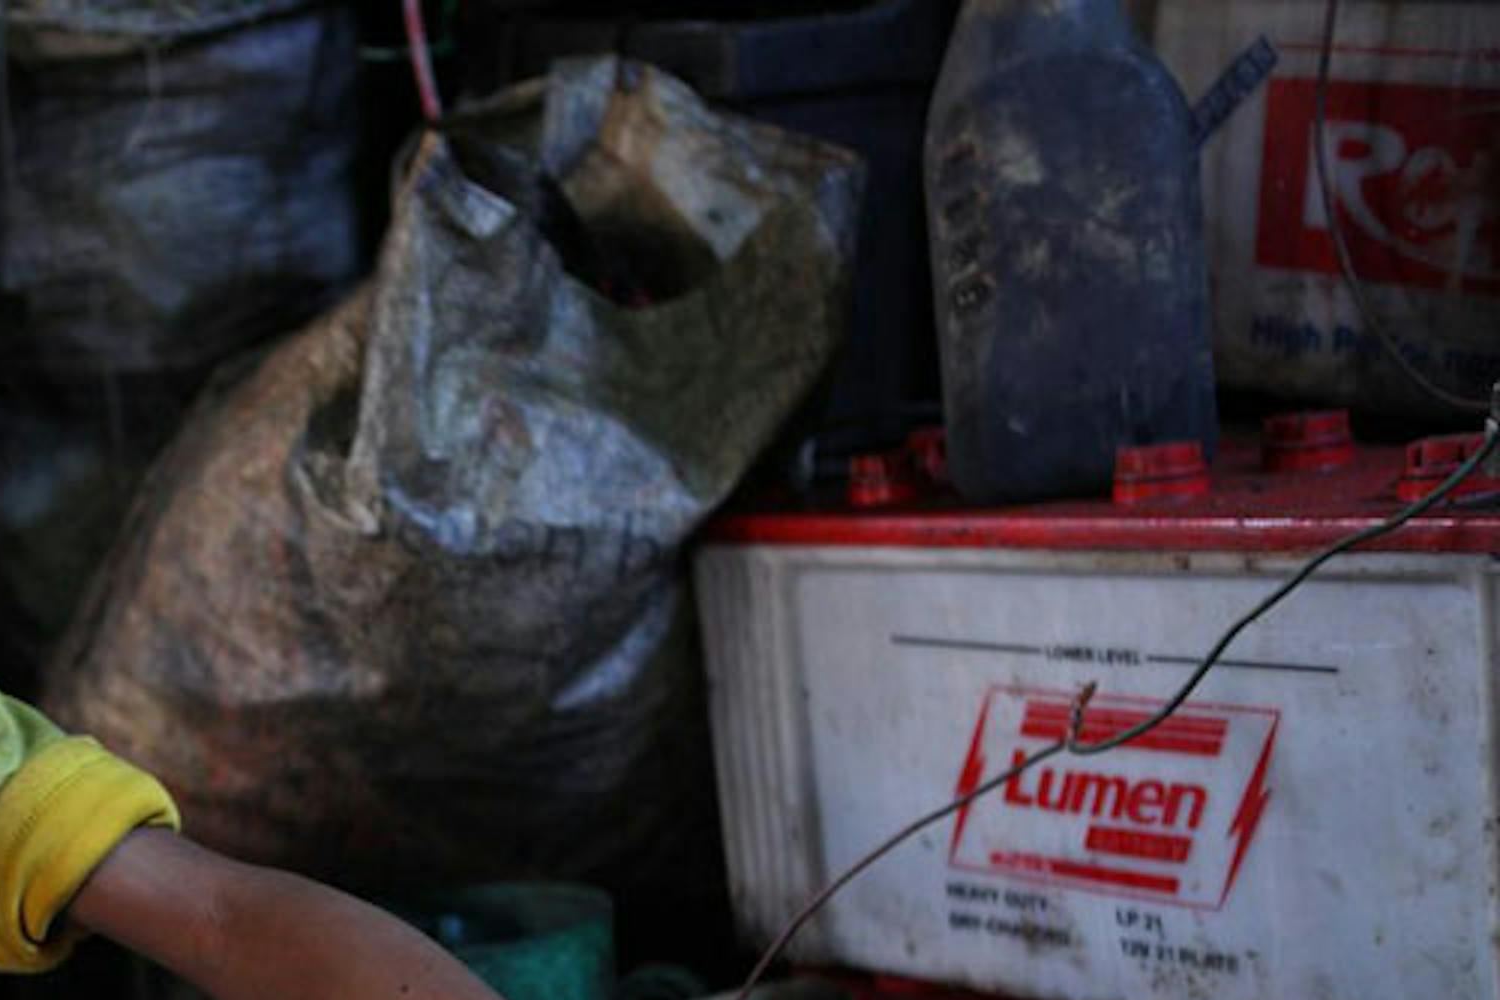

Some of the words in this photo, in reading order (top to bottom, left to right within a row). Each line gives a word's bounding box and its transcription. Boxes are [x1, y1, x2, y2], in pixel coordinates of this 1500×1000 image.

[1098, 648, 1141, 666] LEVEL
[1003, 748, 1208, 830] Lumen
[946, 883, 998, 904] HEAVY
[1004, 889, 1047, 910] DUTY
